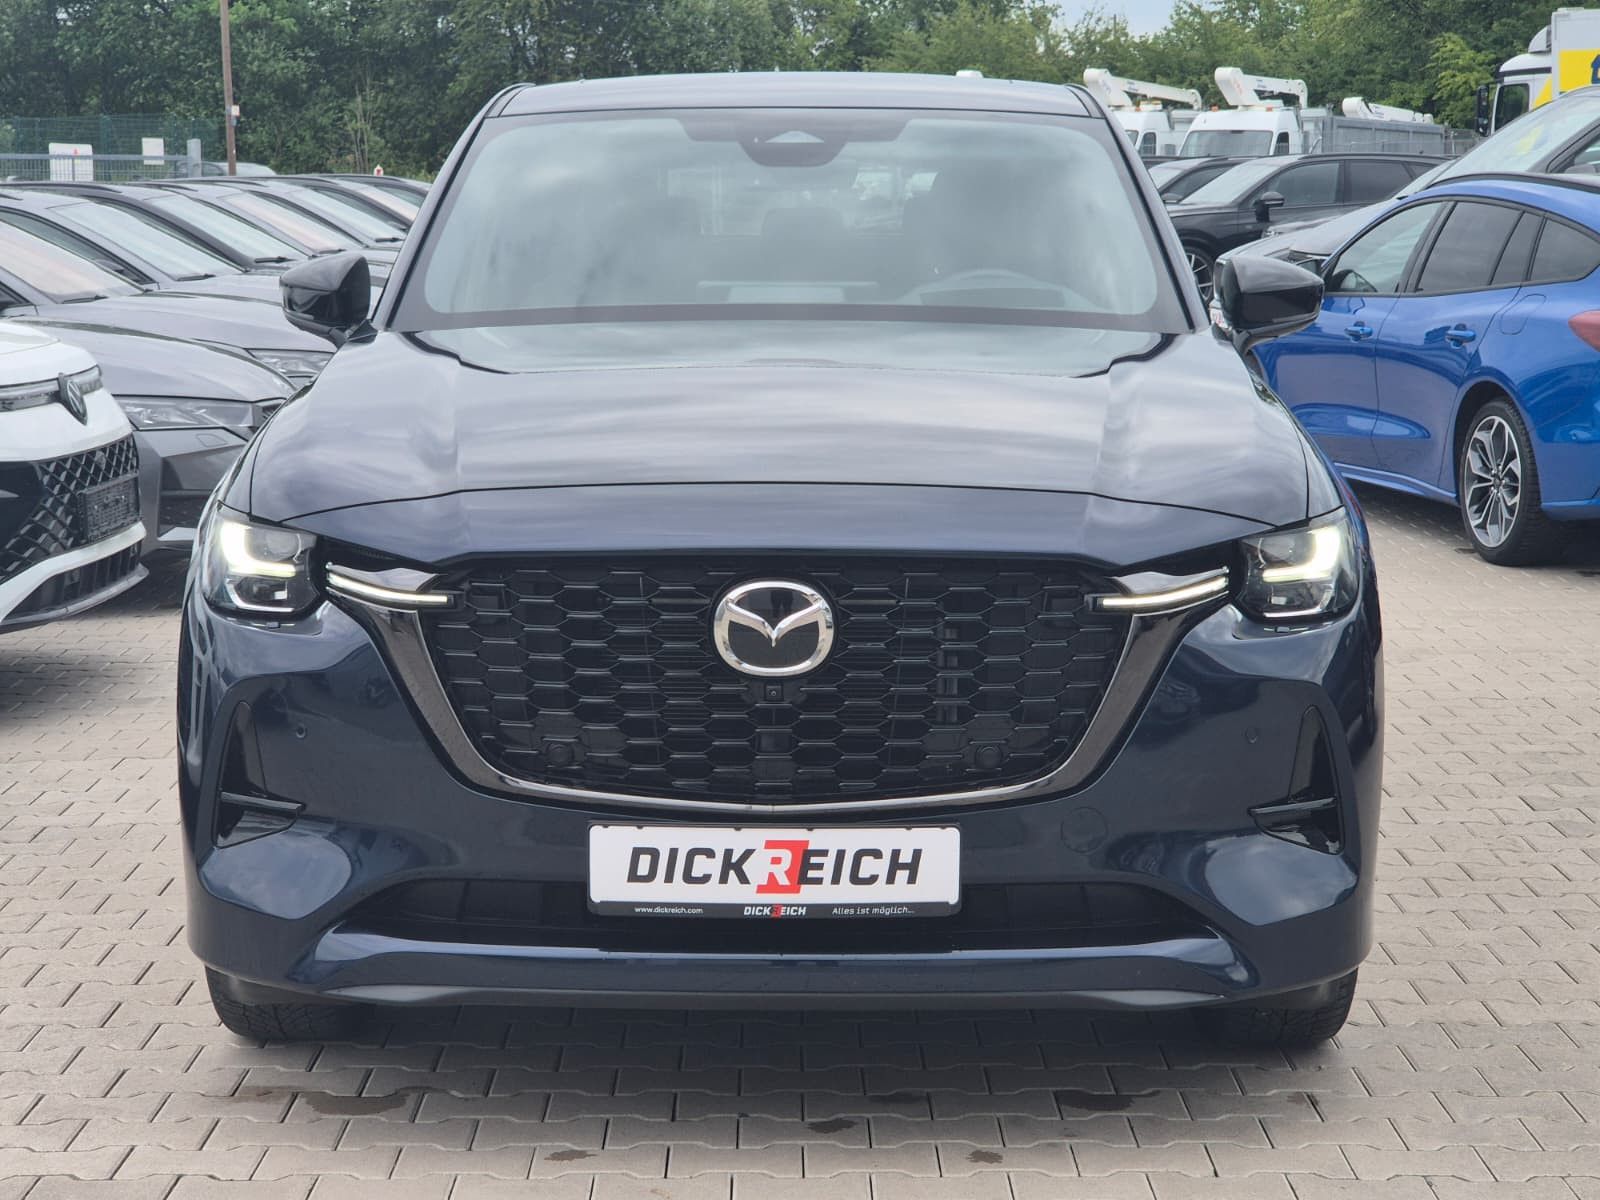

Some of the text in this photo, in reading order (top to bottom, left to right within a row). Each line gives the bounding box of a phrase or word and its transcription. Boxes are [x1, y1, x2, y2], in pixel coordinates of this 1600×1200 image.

[626, 844, 923, 888] DICKREICH
[634, 905, 704, 914] www.dickreich.com
[832, 907, 855, 915] Alles
[857, 906, 870, 915] ist
